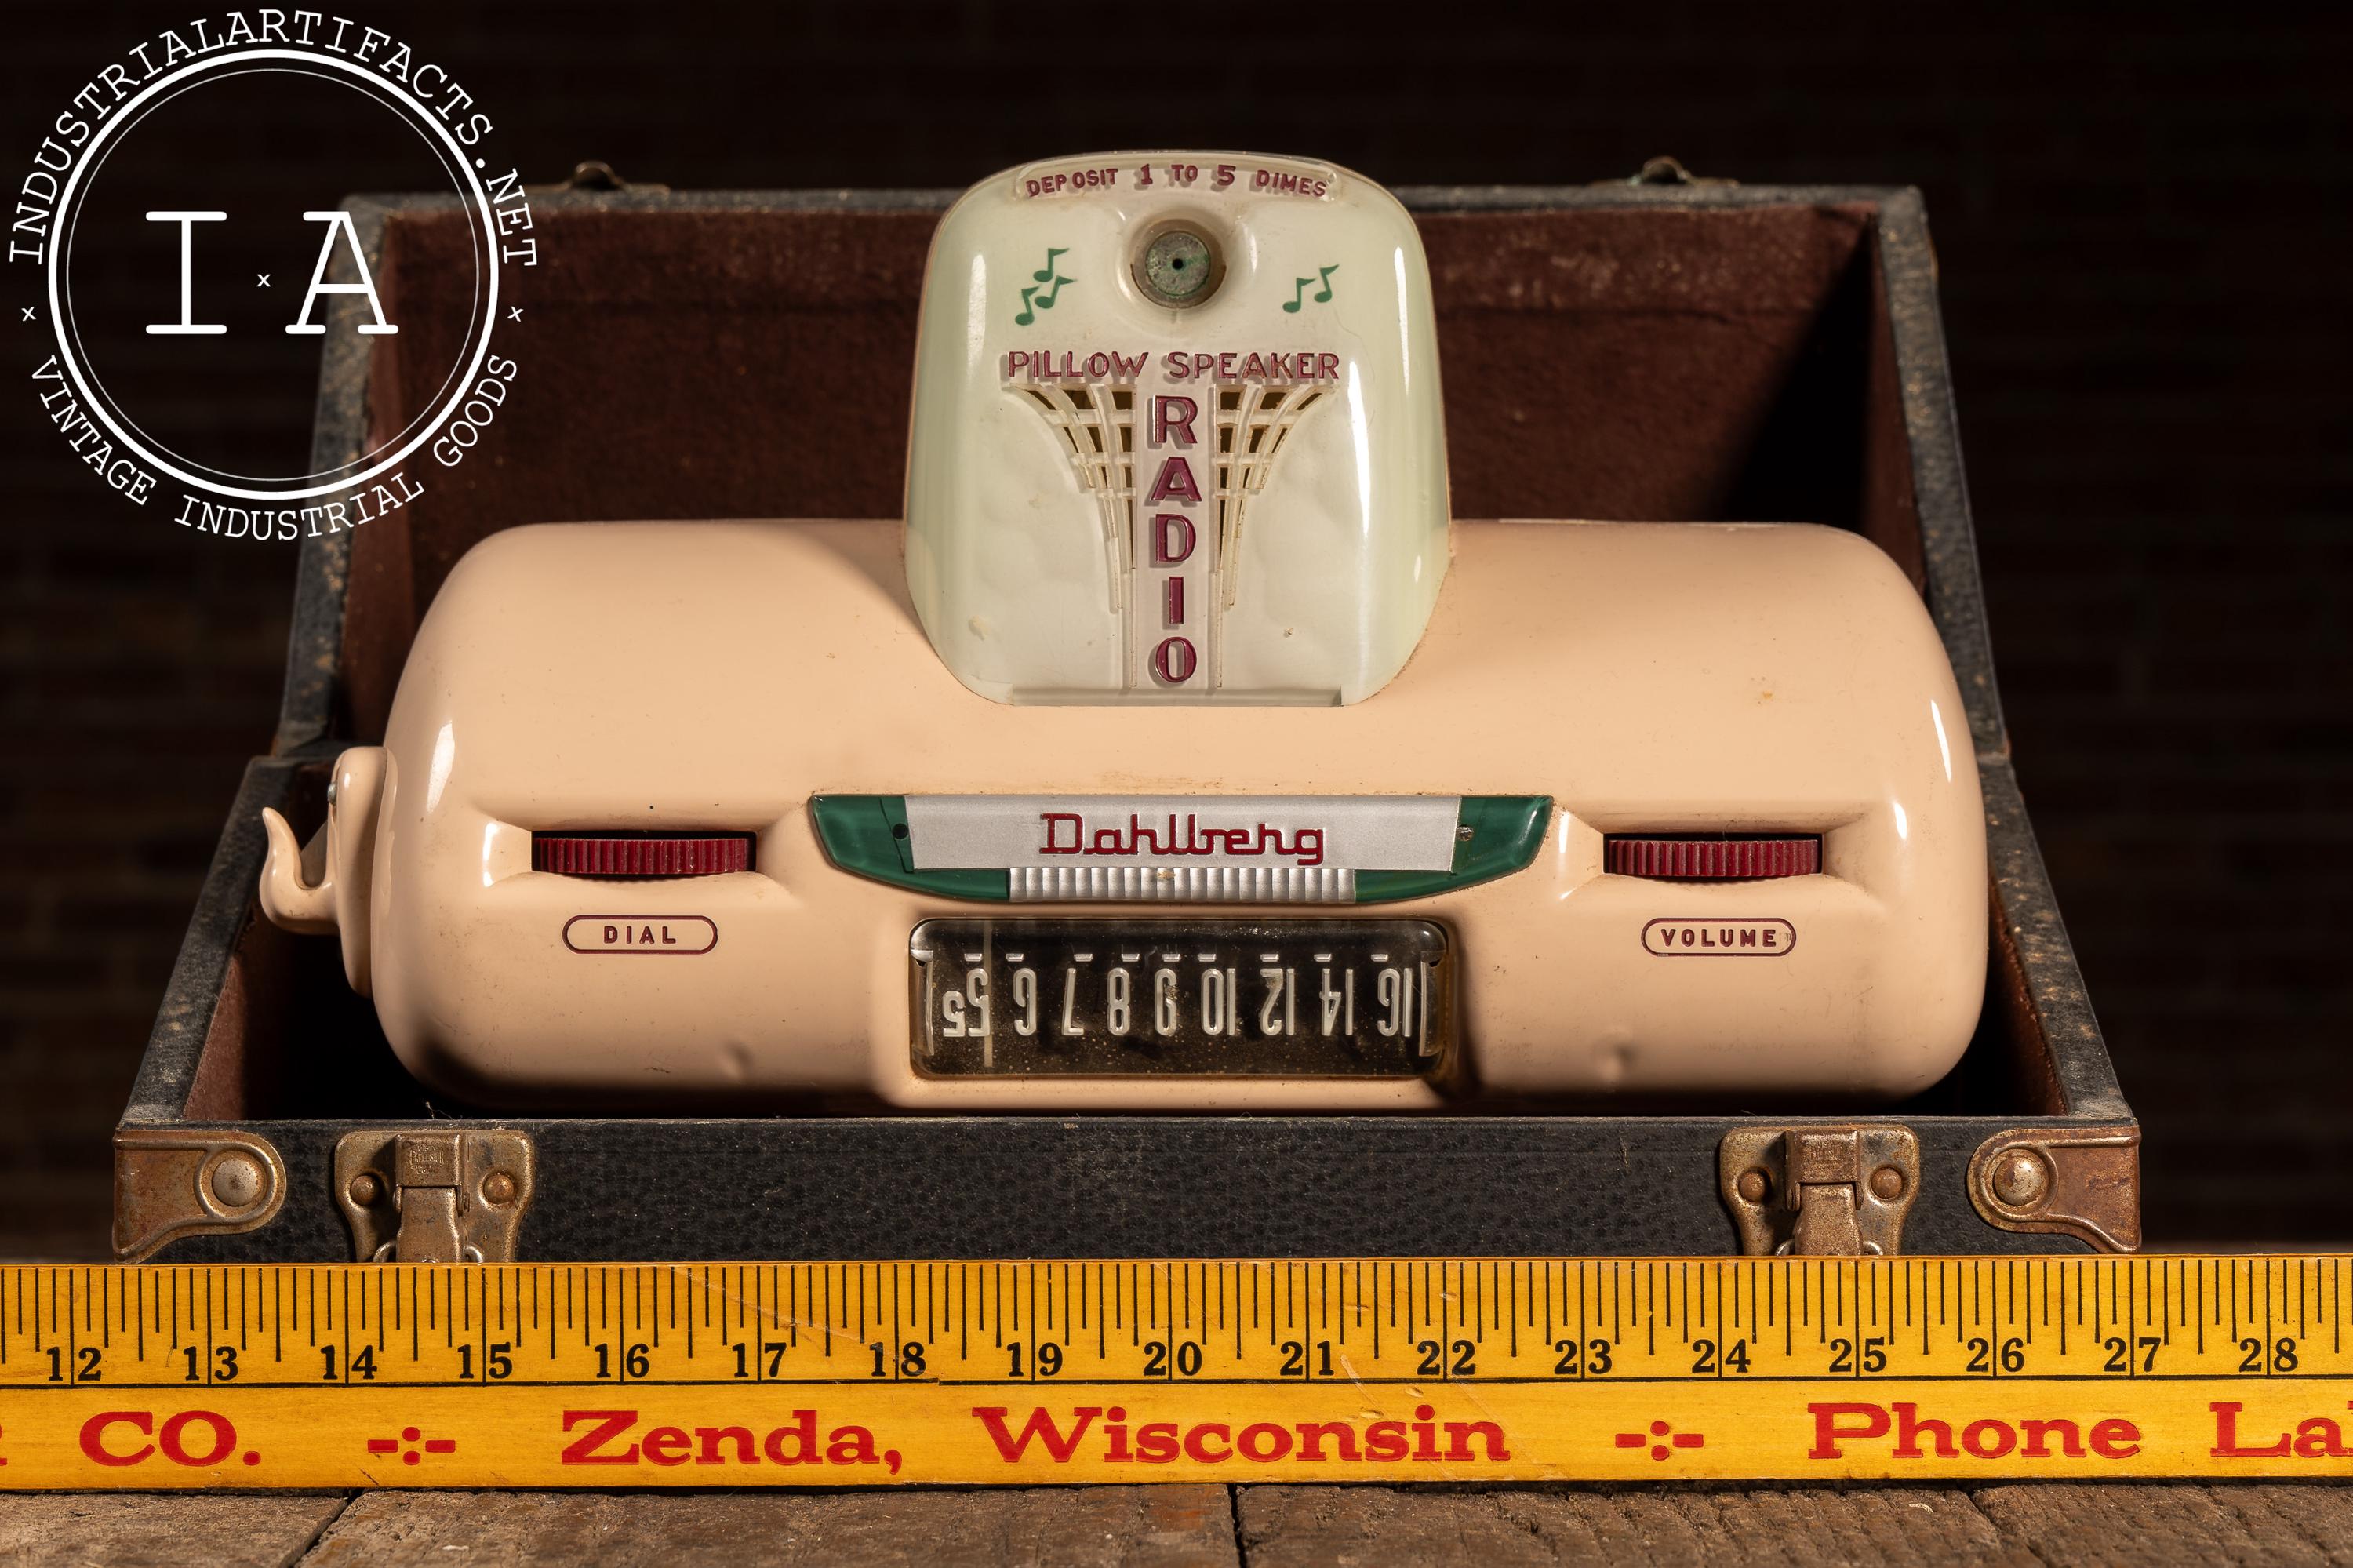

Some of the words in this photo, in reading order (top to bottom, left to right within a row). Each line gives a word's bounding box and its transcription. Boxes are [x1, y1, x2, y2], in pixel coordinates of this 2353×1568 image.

[1025, 167, 1118, 198] DEPOSIT
[1140, 164, 1153, 185] 1
[1170, 164, 1198, 183] TO
[1217, 164, 1236, 187] 5
[1256, 169, 1327, 198] DIMES
[1008, 351, 1149, 378] PILLOW
[1167, 351, 1340, 380] SPEAKER
[1150, 395, 1203, 682] RADIO
[1039, 813, 1324, 865] Dahlberg
[603, 925, 677, 944] DIAL
[1660, 928, 1777, 948] VOLUME
[1061, 967, 1085, 1036] 7
[1107, 967, 1131, 1036] 8
[1201, 967, 1236, 1036] 10
[1260, 967, 1295, 1036] 12
[1319, 967, 1354, 1036] 14
[1377, 967, 1412, 1037] 16
[47, 1346, 101, 1381] 12
[184, 1346, 238, 1381] 13
[320, 1345, 378, 1381] 14
[458, 1342, 513, 1380] 15
[594, 1342, 650, 1378] 16
[733, 1342, 787, 1378] 17
[869, 1341, 927, 1377] 18
[1007, 1341, 1064, 1377] 19
[1143, 1341, 1202, 1377] 20
[1280, 1340, 1334, 1377] 21
[1417, 1339, 1476, 1376] 22
[1555, 1338, 1613, 1375] 23
[1692, 1338, 1751, 1375] 24
[1829, 1337, 1887, 1373] 25
[1966, 1337, 2024, 1373] 26
[2104, 1337, 2162, 1373] 27
[2238, 1337, 2299, 1373] 28
[79, 1410, 261, 1467] CO.
[561, 1409, 903, 1475] Zenda,
[971, 1404, 1511, 1464] Wisconsin
[1807, 1402, 2141, 1459] Phone
[2209, 1400, 2353, 1458] La
